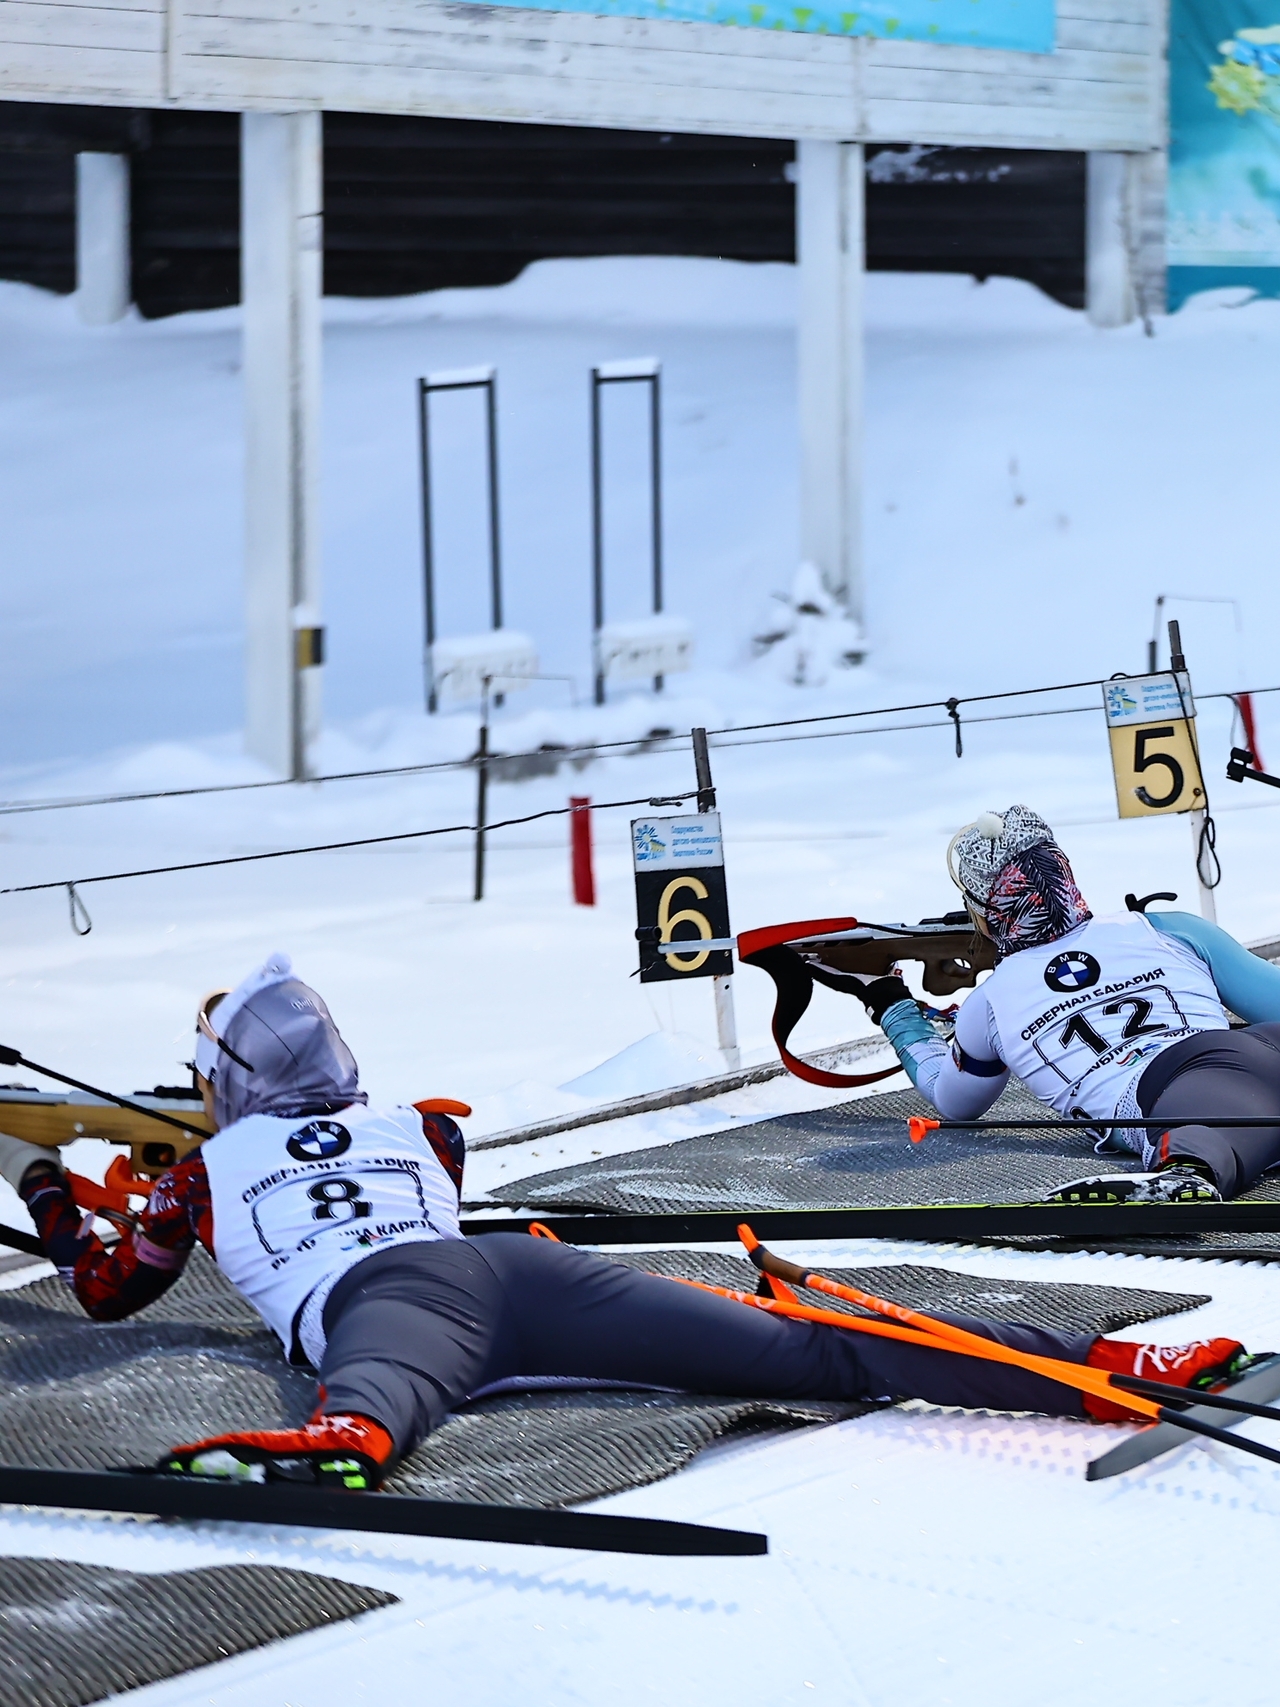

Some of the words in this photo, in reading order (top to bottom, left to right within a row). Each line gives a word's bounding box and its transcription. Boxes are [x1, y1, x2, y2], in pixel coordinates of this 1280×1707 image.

[1133, 726, 1184, 808] 5
[657, 876, 713, 972] 6
[1047, 952, 1088, 974] BMW
[1059, 996, 1169, 1057] 12
[306, 1178, 373, 1221] 8
